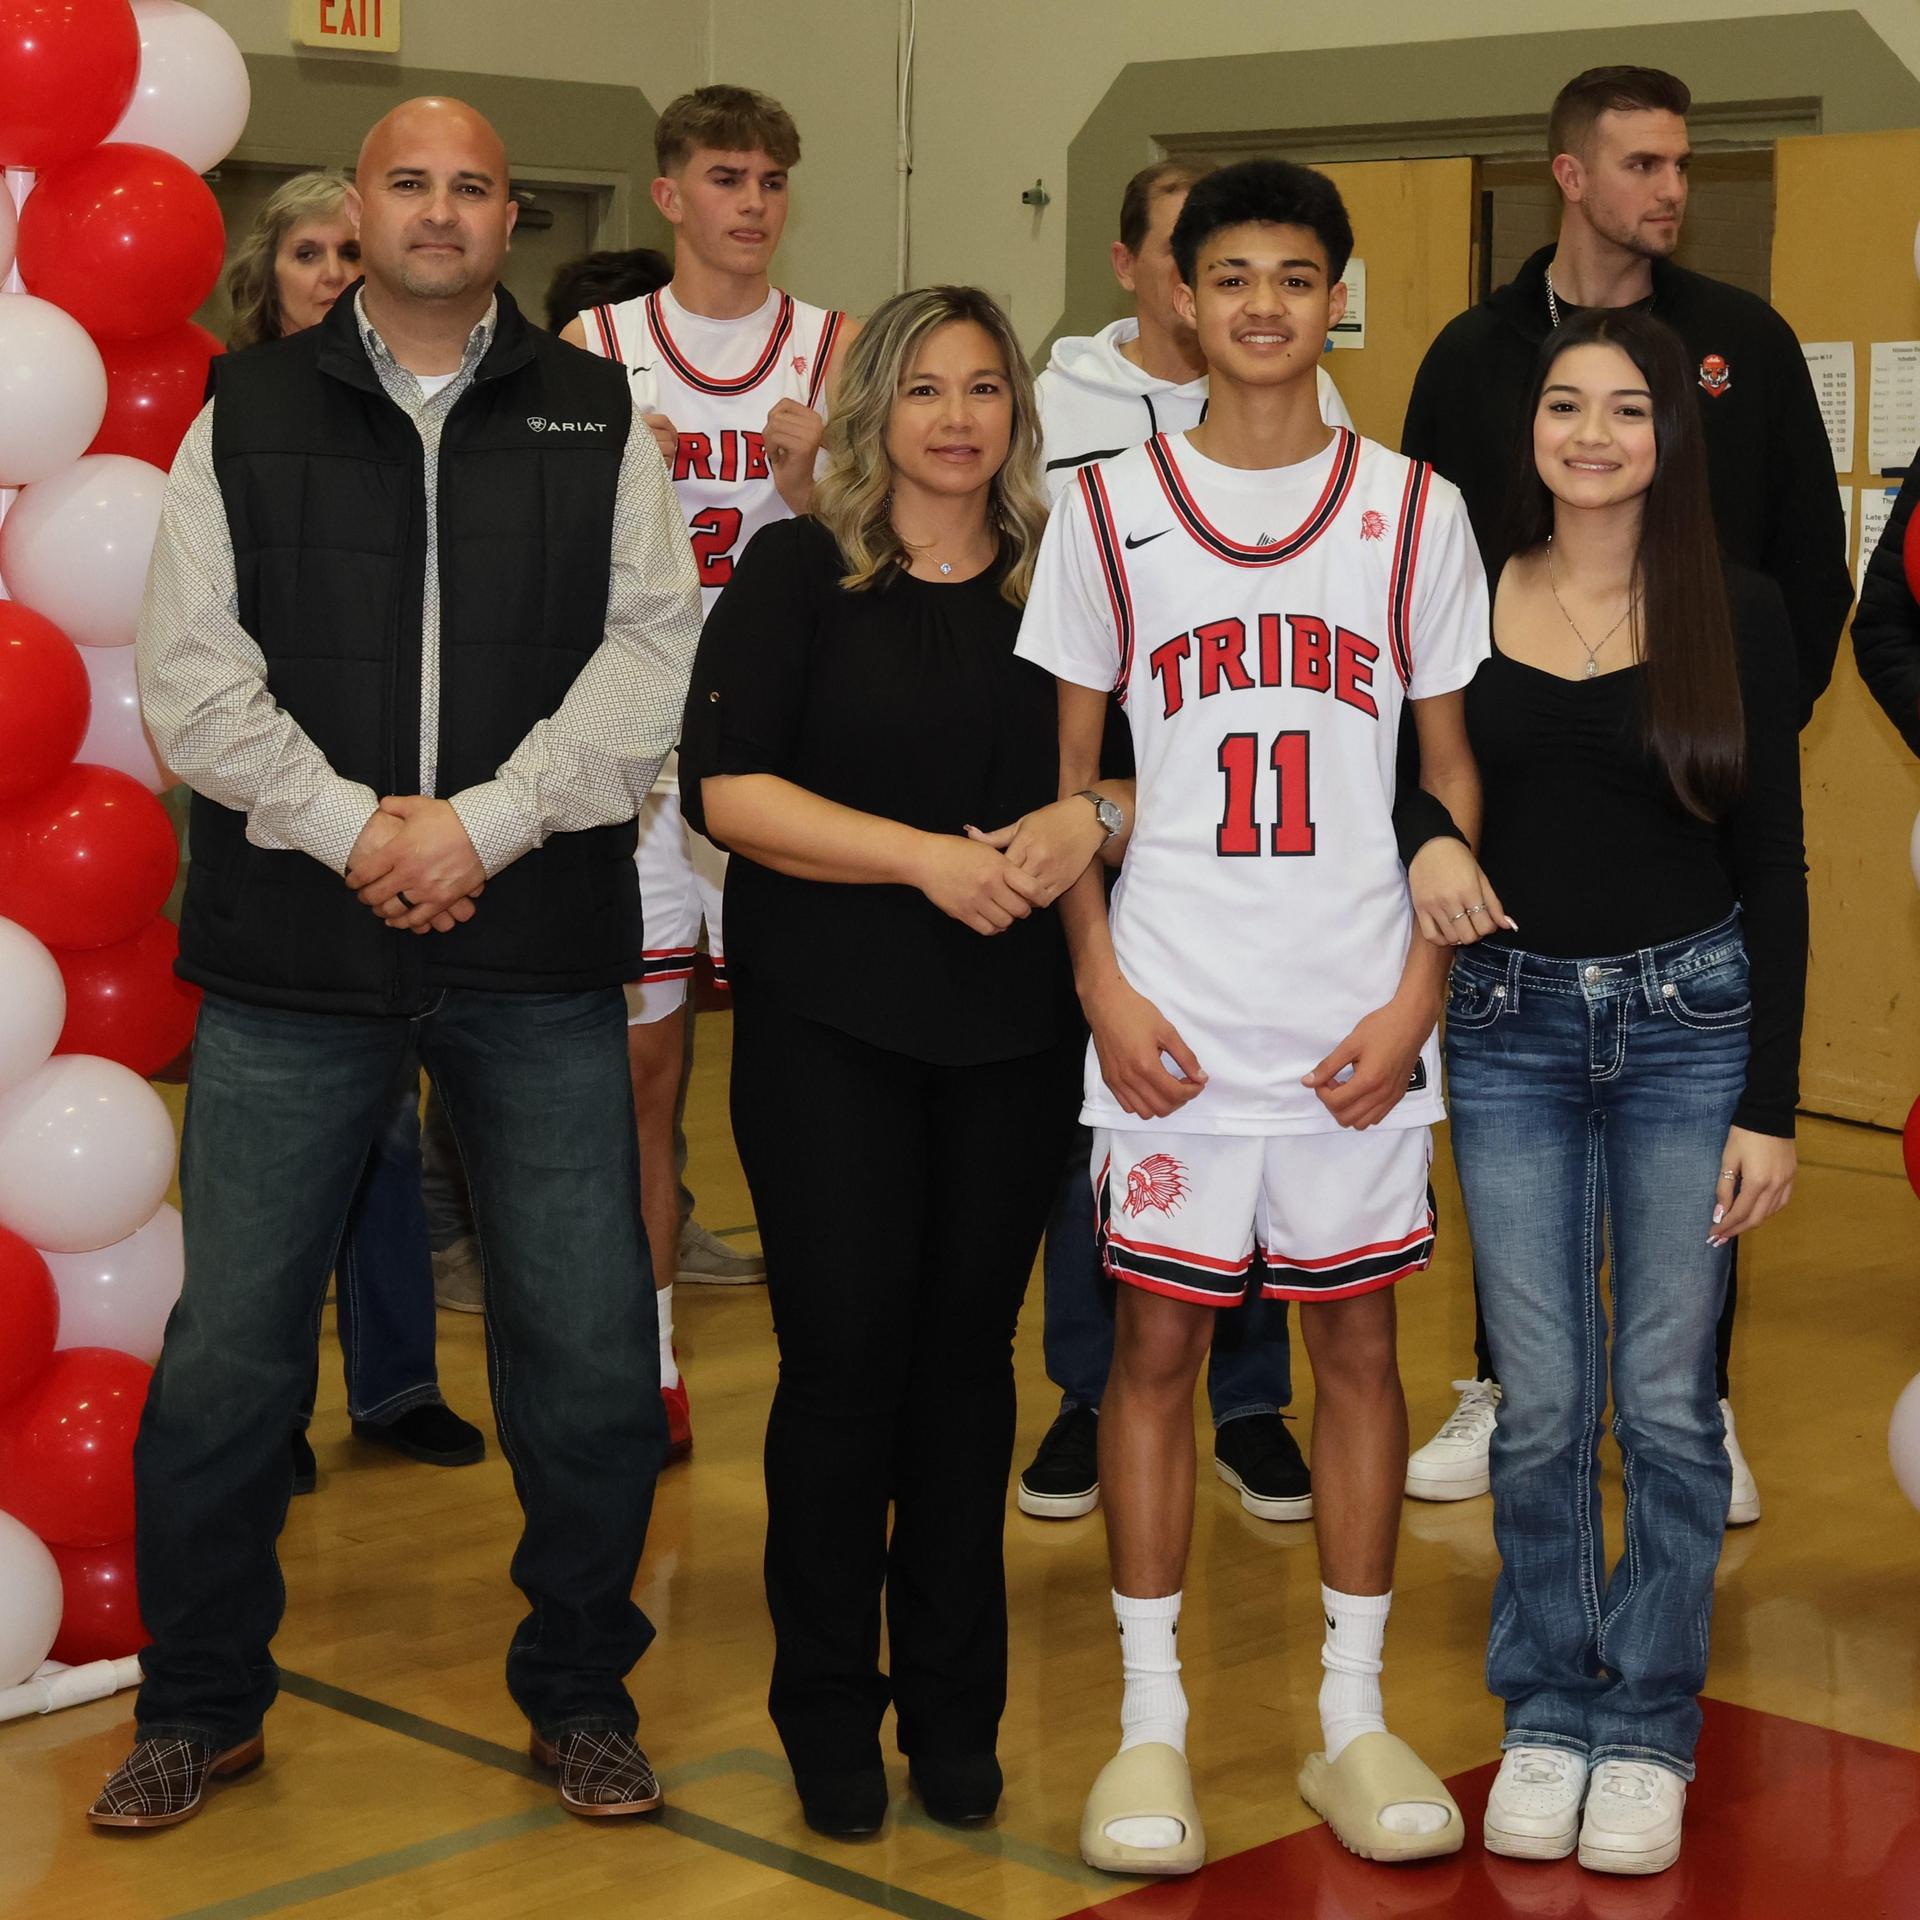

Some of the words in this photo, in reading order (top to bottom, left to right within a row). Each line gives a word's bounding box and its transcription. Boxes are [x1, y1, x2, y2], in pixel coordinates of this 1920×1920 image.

[547, 422, 607, 433] ARIAT
[672, 430, 773, 482] RIB
[689, 507, 743, 587] 2
[1150, 613, 1380, 721] TRIBE
[1217, 730, 1315, 857] 11
